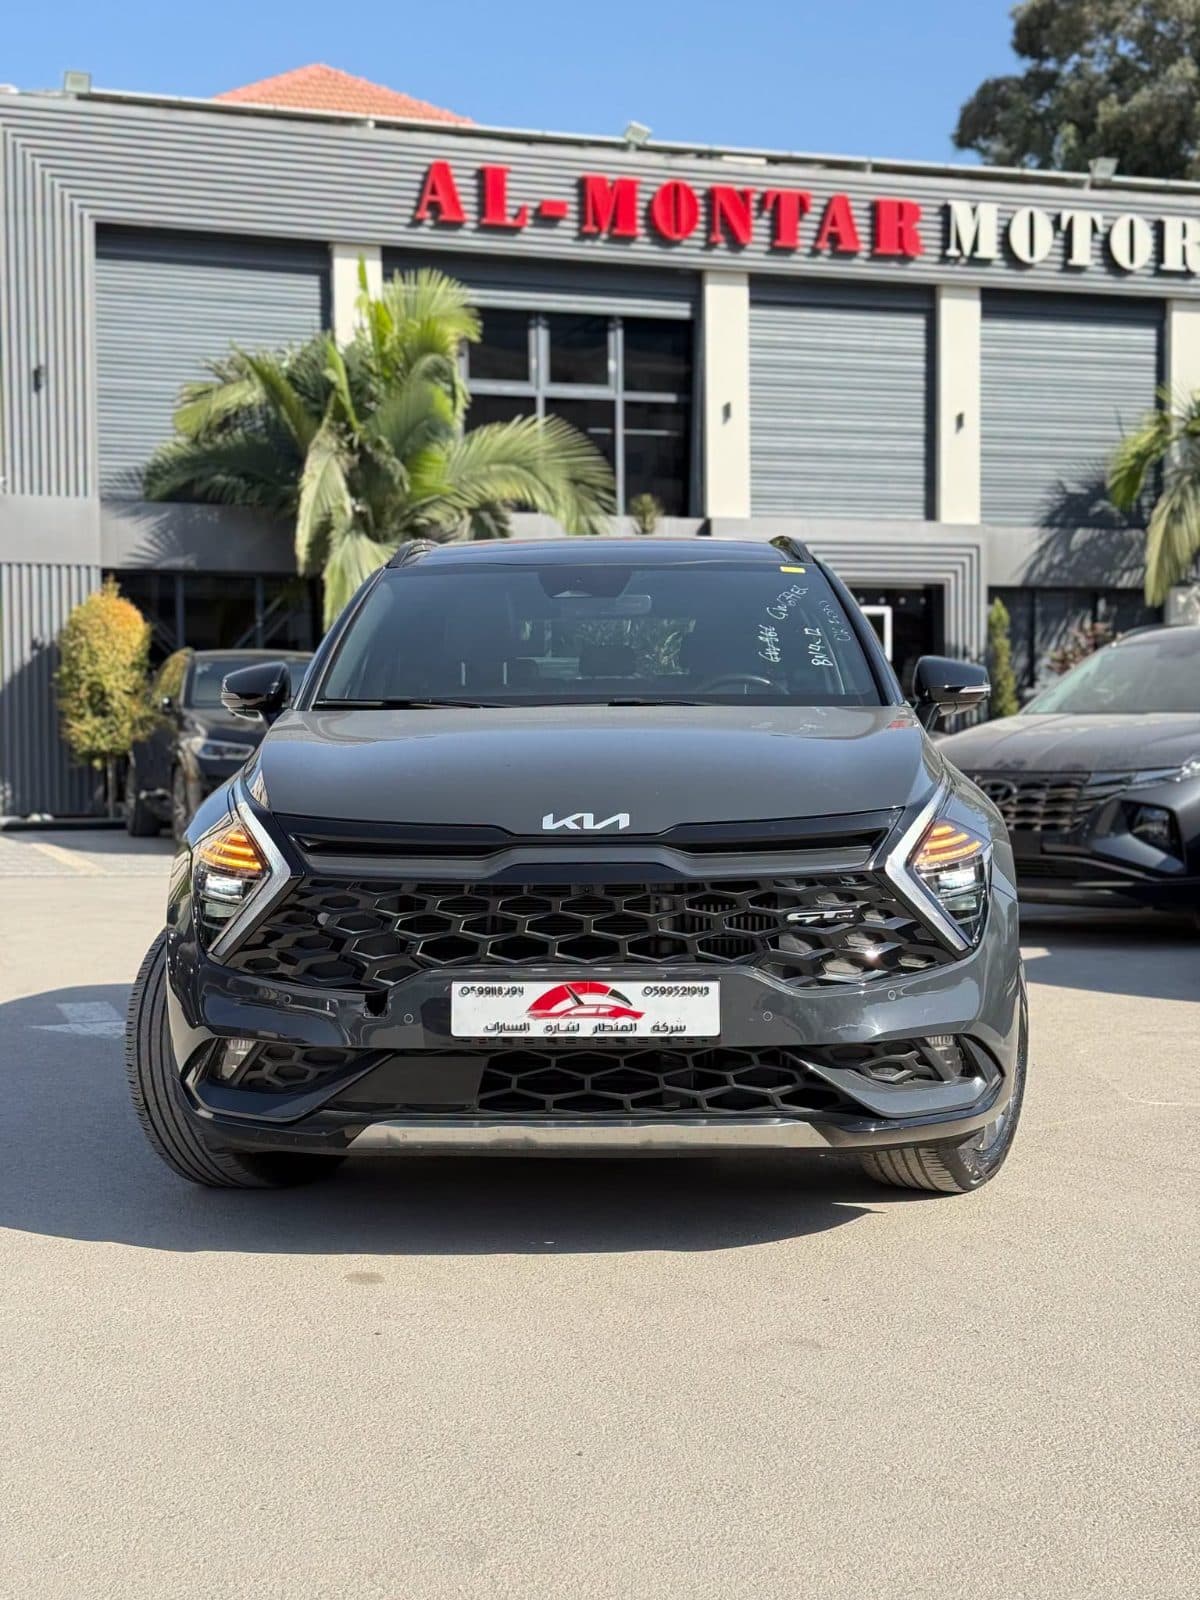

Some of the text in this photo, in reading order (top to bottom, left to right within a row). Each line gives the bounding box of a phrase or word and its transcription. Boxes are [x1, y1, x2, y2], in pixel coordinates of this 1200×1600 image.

[415, 159, 925, 258] AL-MONTAR
[542, 812, 630, 830] KIA
[642, 986, 710, 997] 0599521943
[592, 1022, 637, 1035] المنطار
[651, 1018, 687, 1034] شركة
